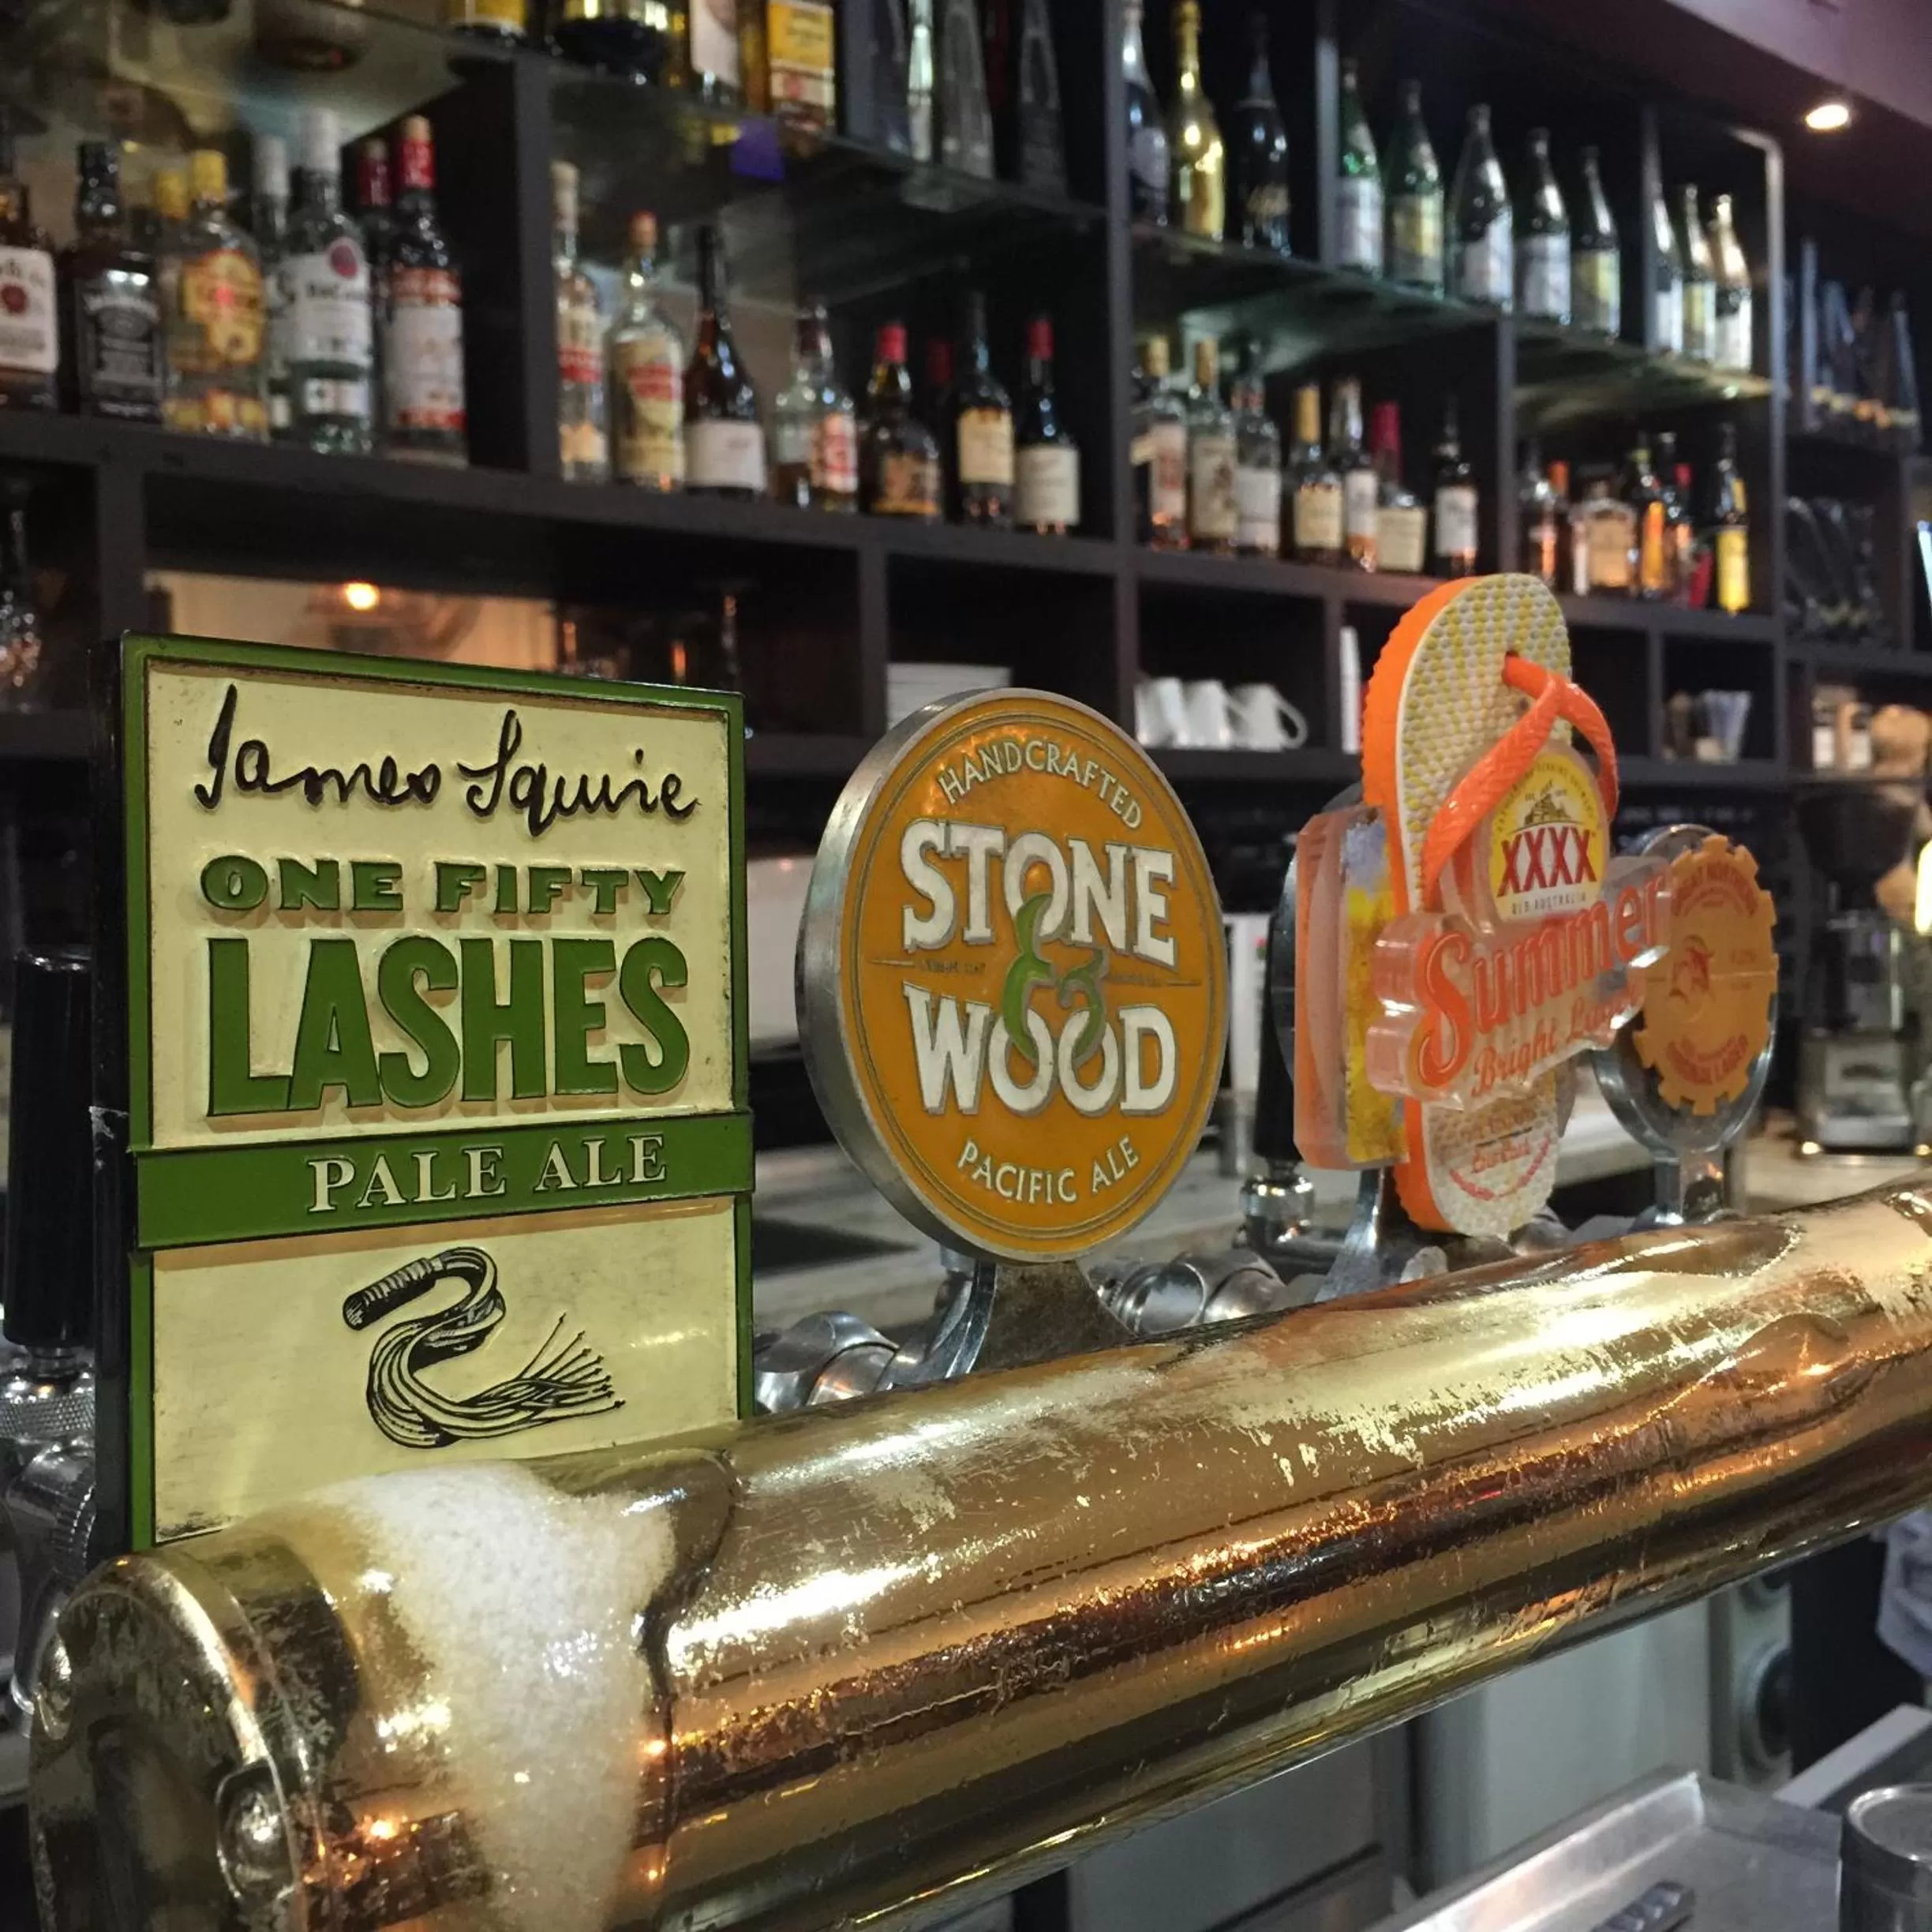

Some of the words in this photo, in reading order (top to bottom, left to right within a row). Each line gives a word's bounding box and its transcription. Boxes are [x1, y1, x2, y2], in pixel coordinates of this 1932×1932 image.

[194, 683, 440, 809] James
[458, 709, 700, 836] Squire
[938, 739, 1143, 829] HANDCRAFTED
[200, 855, 403, 911] ONE
[434, 860, 686, 915] FIFTY
[900, 818, 1178, 968] STONE
[1496, 826, 1597, 898] XXXX
[207, 935, 690, 1117] LASHES
[1420, 872, 1667, 1088] Summer
[903, 981, 1179, 1117] WOOD
[307, 1145, 506, 1214] PALE
[535, 1134, 668, 1194] ALE
[959, 1139, 1078, 1204] PACIFIC
[1091, 1137, 1140, 1194] ALE
